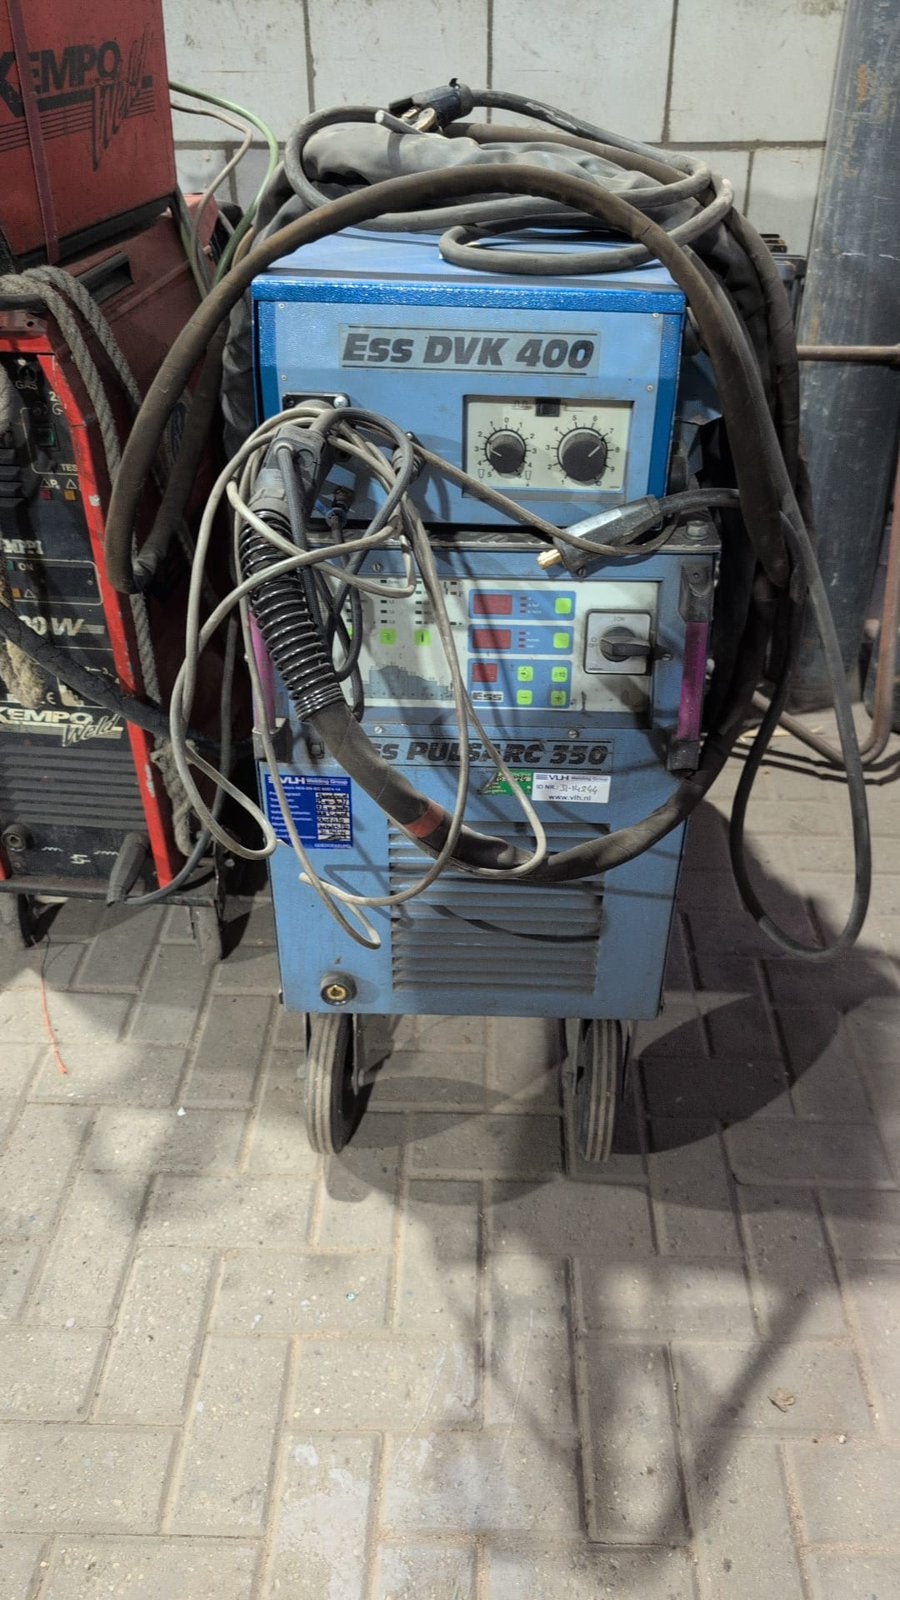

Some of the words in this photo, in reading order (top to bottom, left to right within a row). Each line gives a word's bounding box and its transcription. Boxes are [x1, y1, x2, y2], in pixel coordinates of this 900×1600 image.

[423, 335, 510, 366] DVK
[515, 338, 595, 370] 400
[60, 463, 79, 472] TES
